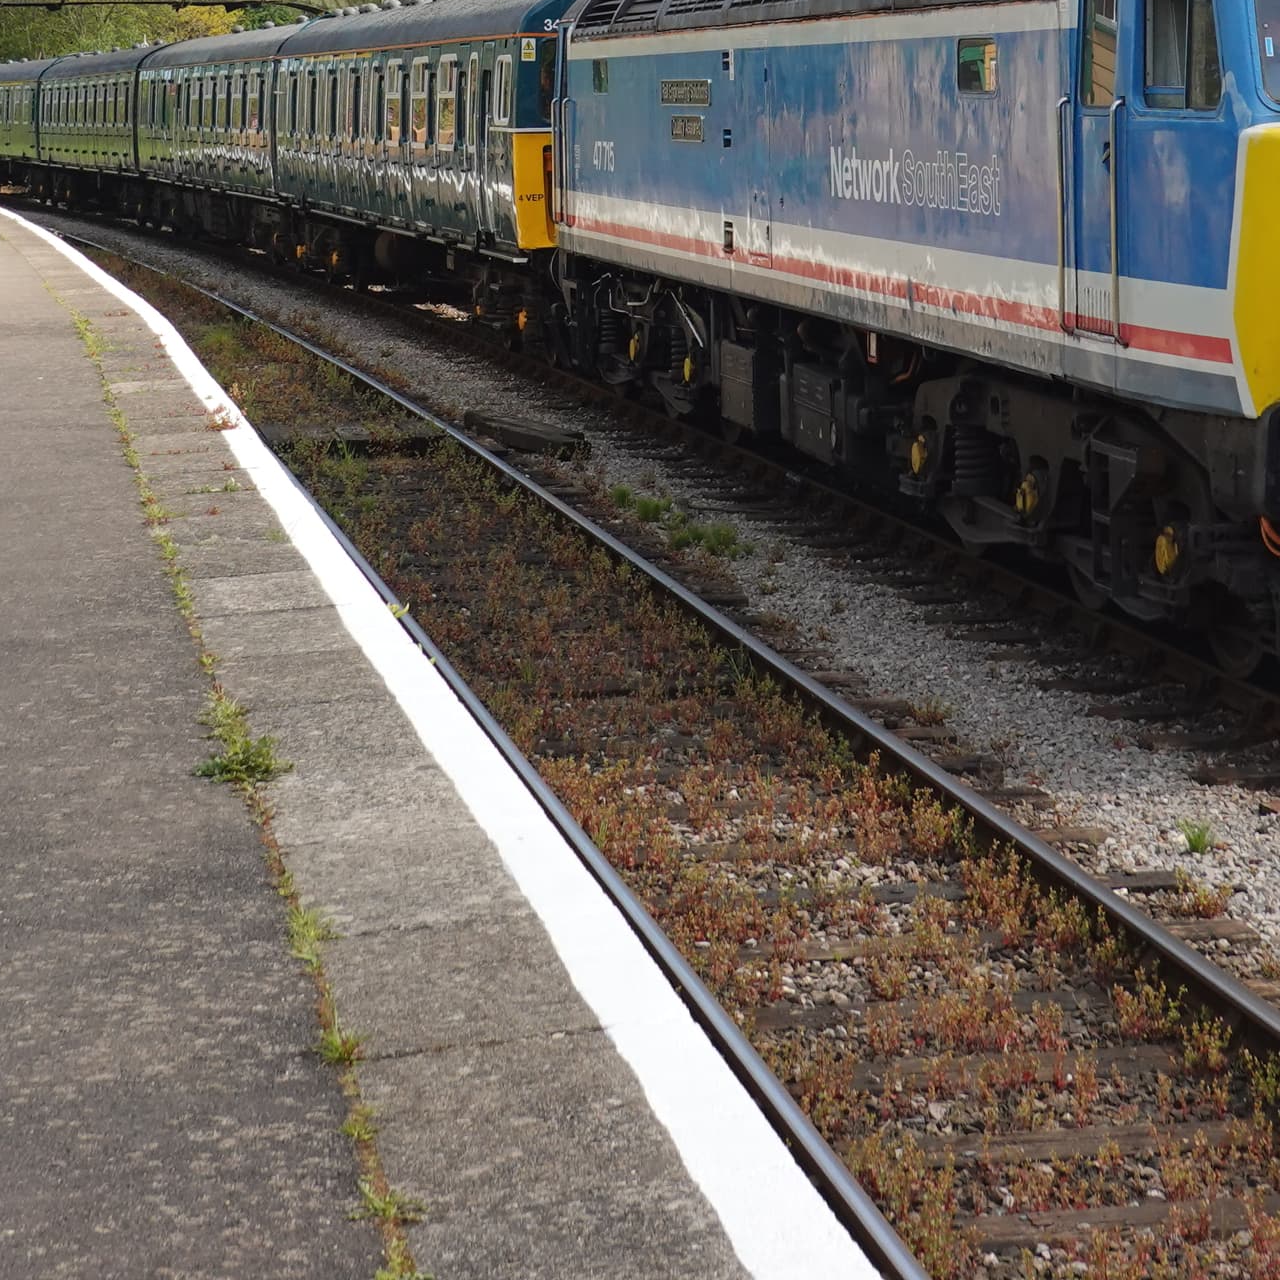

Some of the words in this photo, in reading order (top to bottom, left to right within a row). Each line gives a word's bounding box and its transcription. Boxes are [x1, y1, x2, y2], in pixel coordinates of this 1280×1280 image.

[525, 193, 544, 202] VEP
[830, 146, 902, 204] Network
[902, 148, 1001, 216] SouthEast
